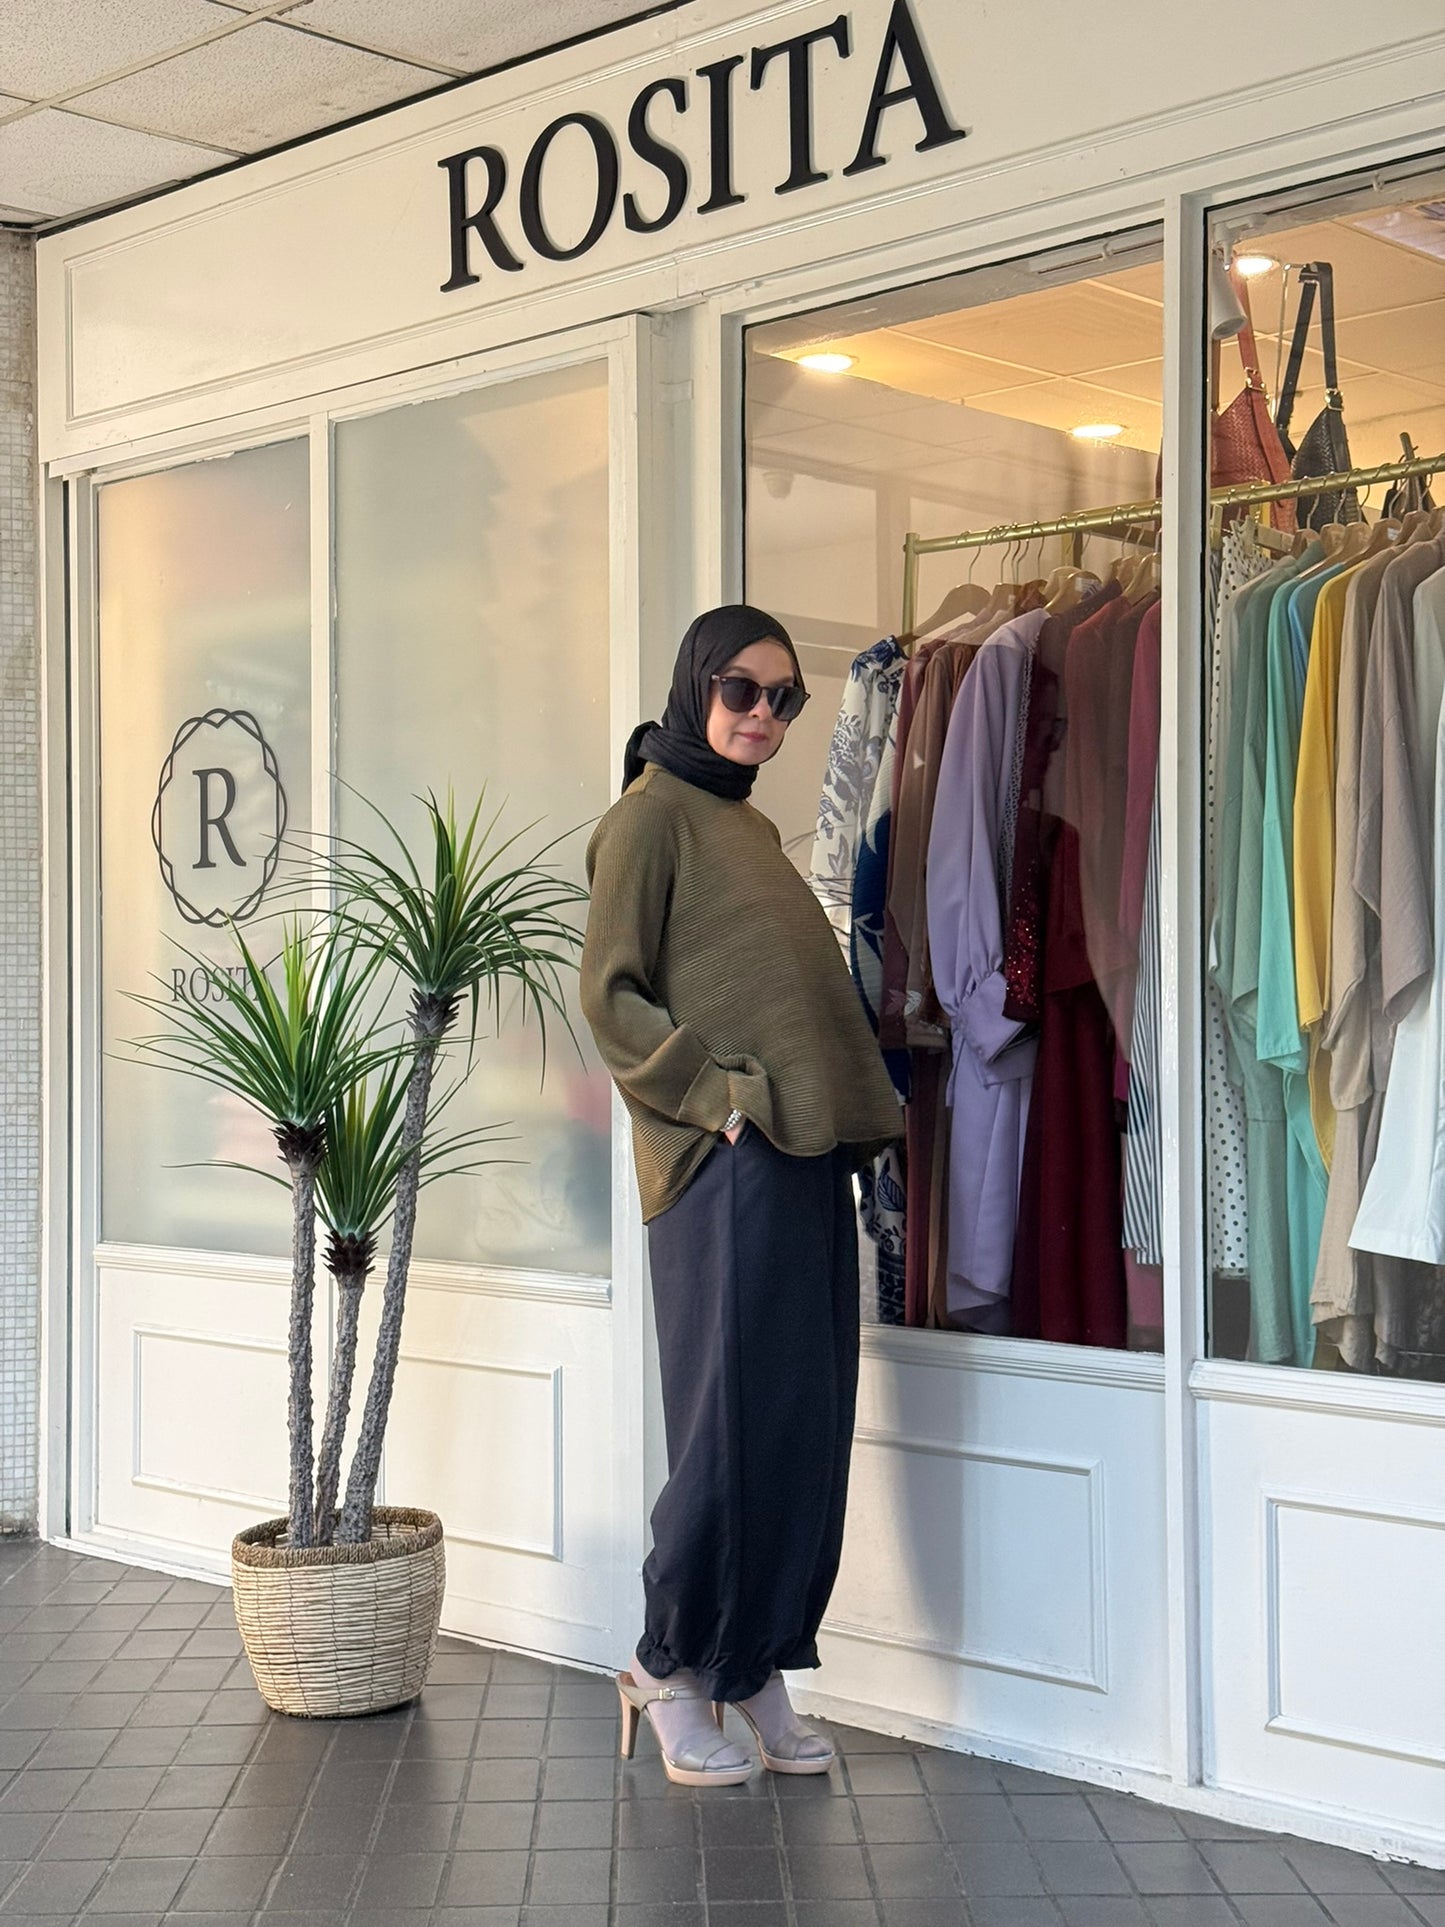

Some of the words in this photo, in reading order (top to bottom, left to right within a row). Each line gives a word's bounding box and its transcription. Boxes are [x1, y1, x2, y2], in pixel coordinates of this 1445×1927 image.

[437, 0, 967, 293] ROSITA
[192, 767, 247, 869] R
[171, 966, 272, 1002] ROSIT
